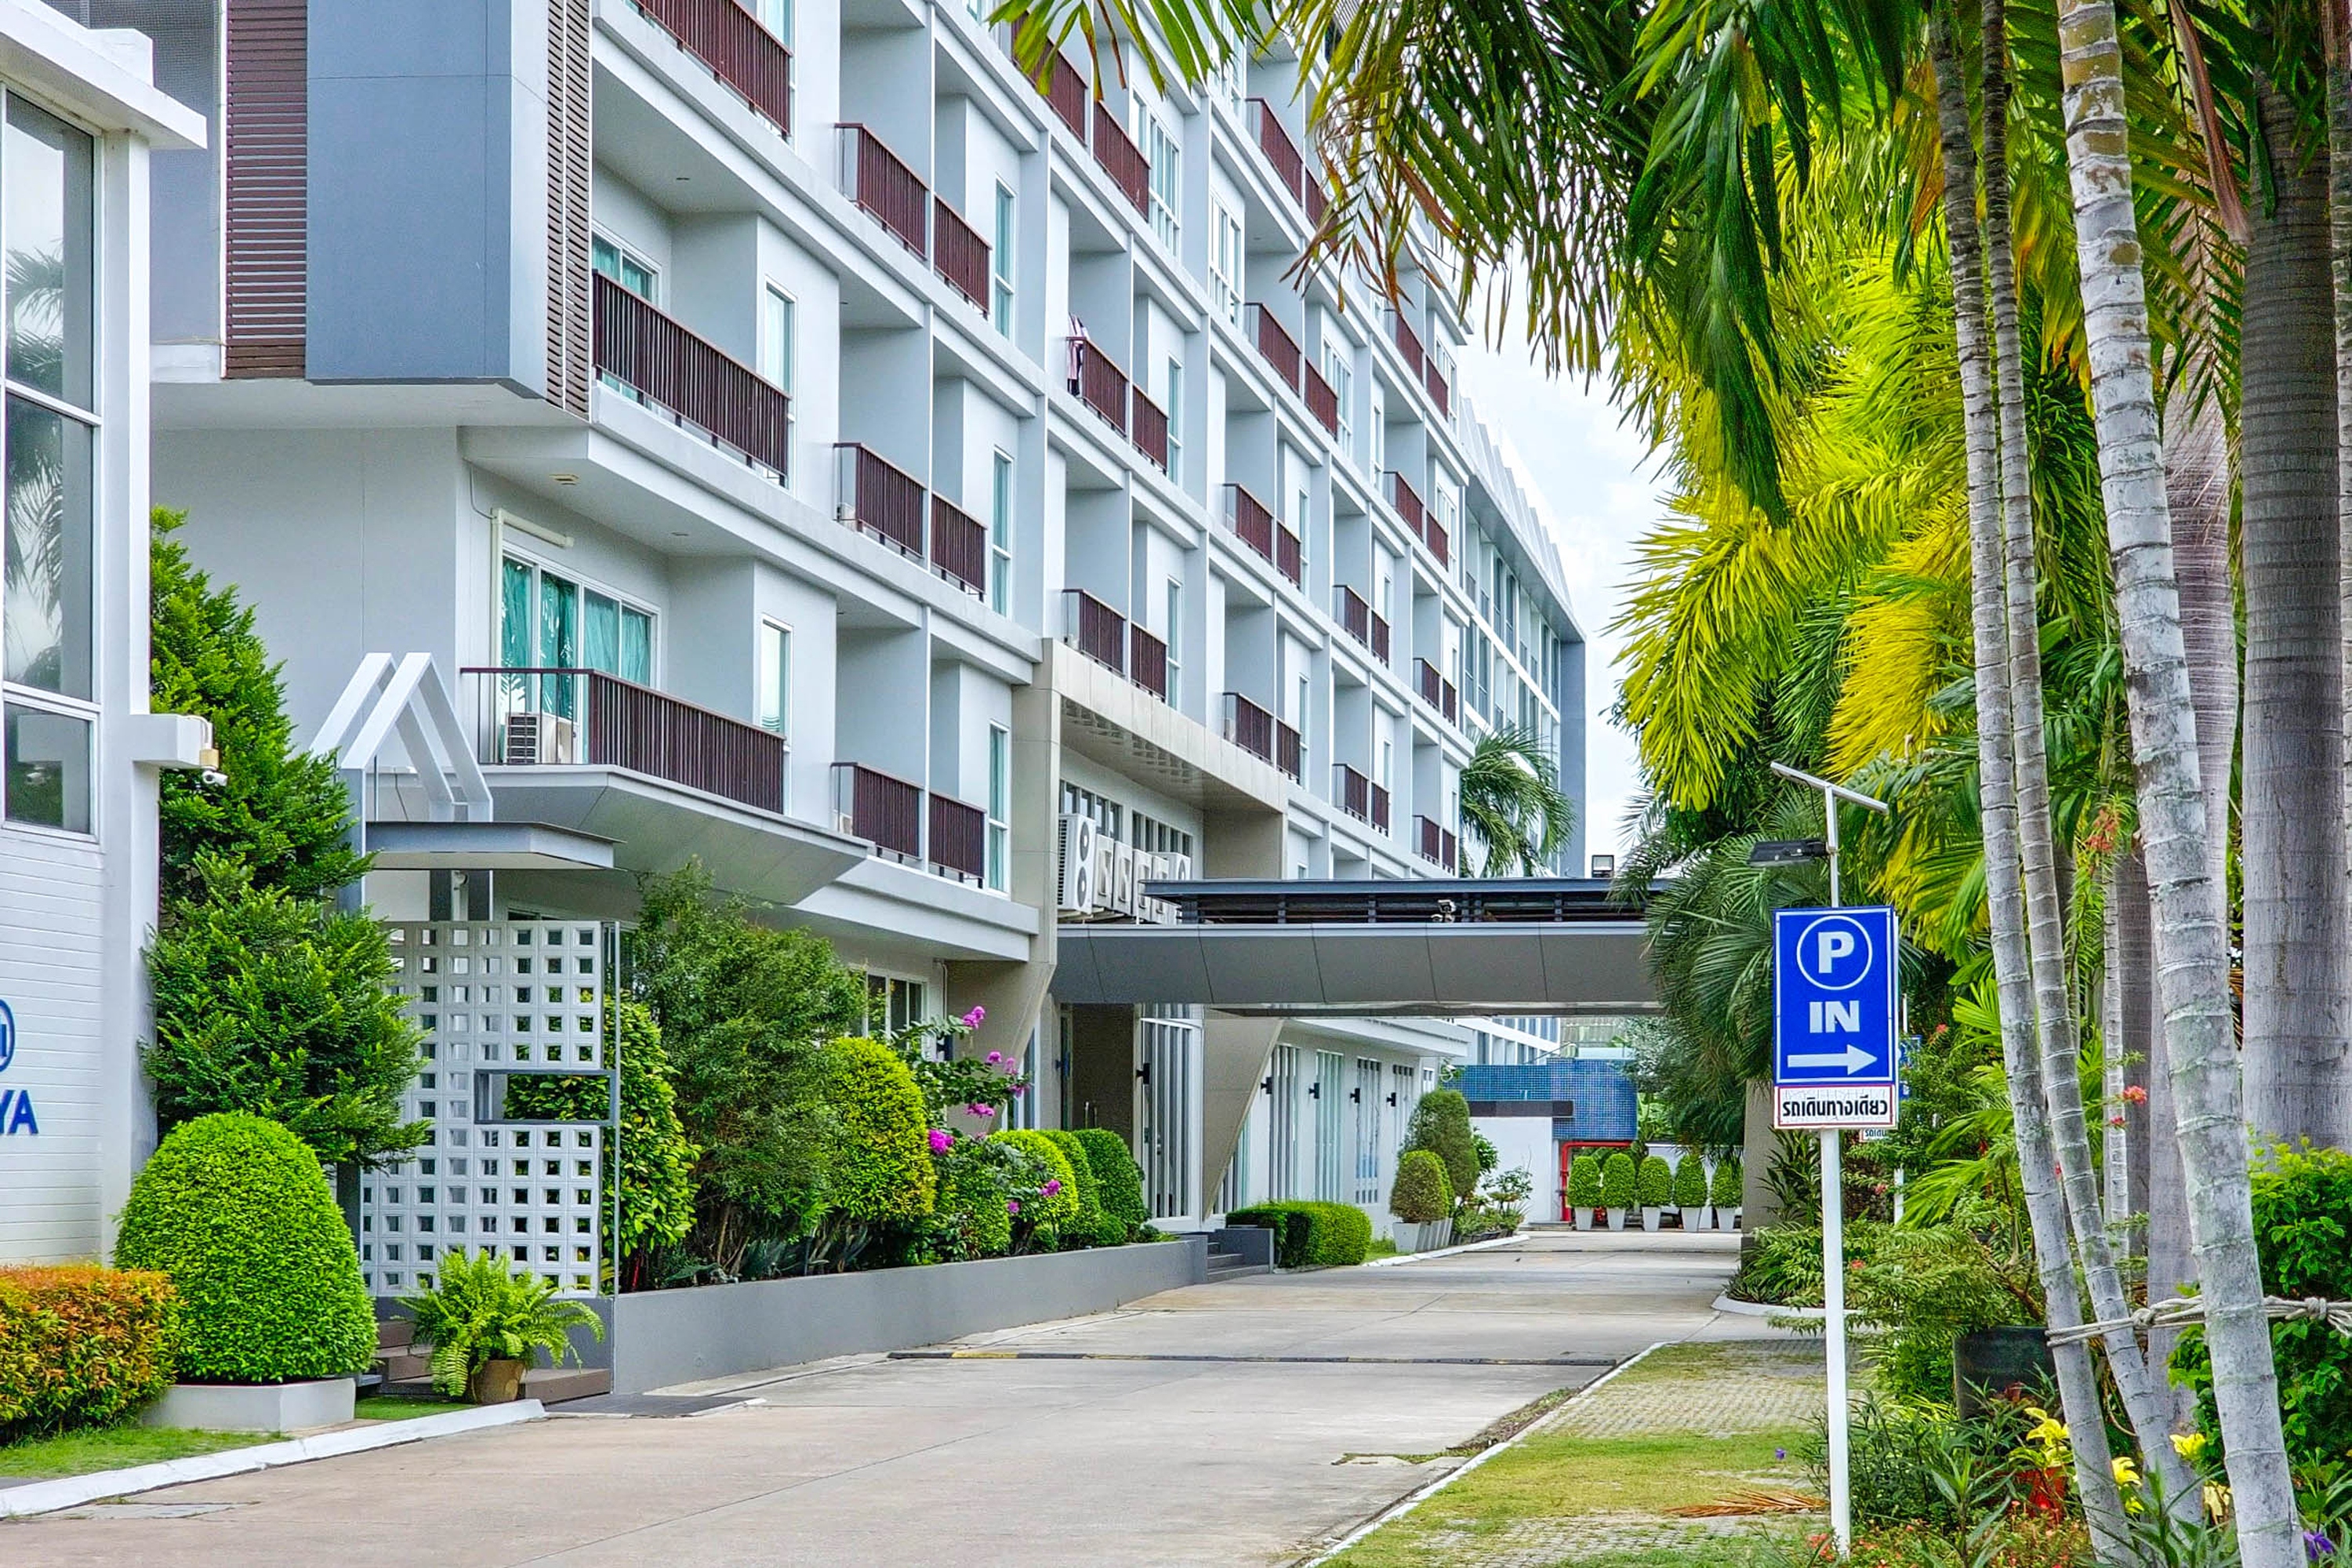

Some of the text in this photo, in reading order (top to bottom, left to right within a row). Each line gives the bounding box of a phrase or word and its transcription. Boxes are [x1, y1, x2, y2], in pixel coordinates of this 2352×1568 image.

[1818, 931, 1855, 974] P
[1809, 1000, 1860, 1033] IN
[1782, 1094, 1888, 1116] รถเดินทางเดียว
